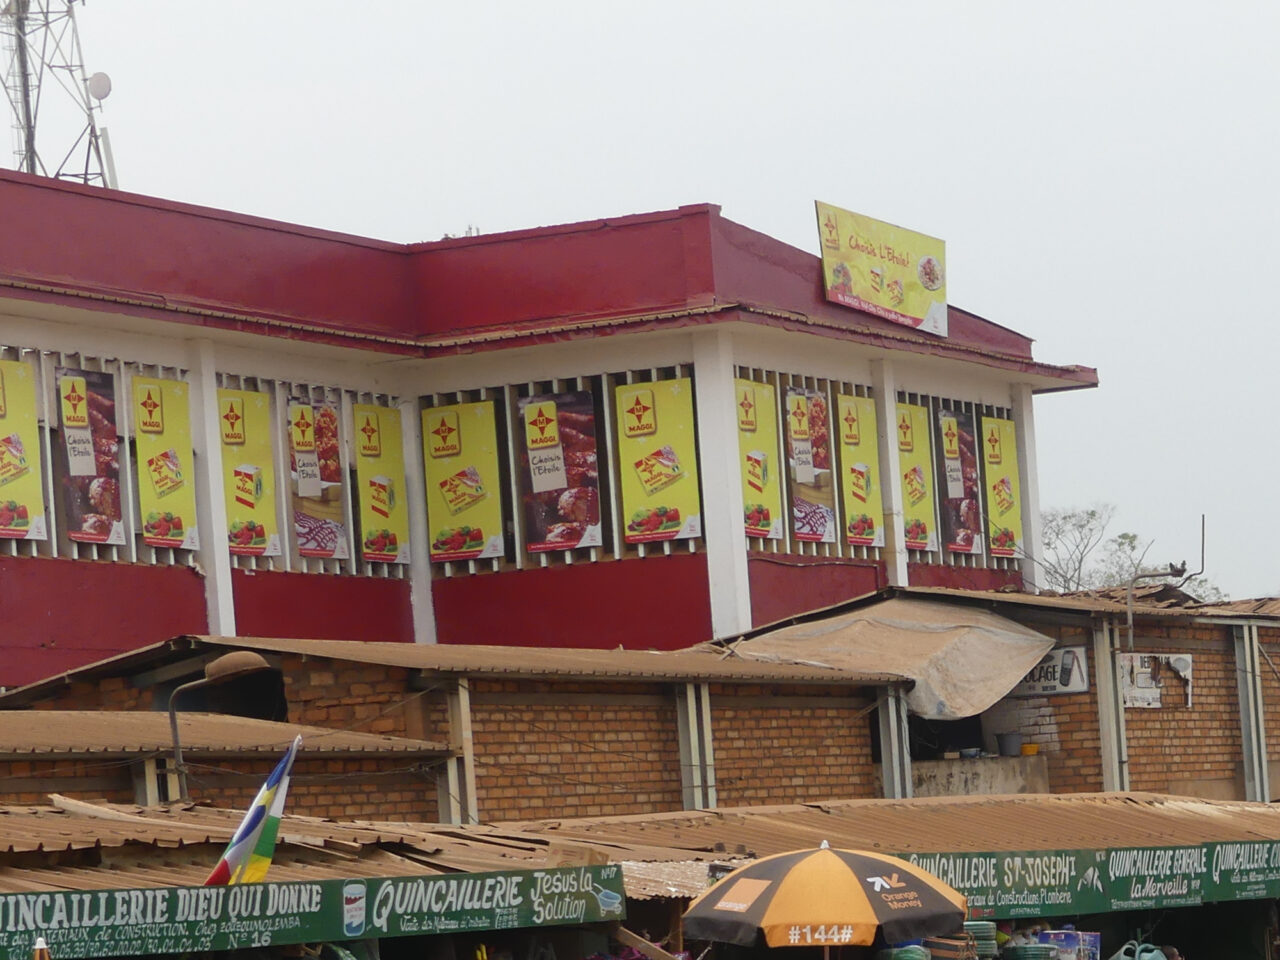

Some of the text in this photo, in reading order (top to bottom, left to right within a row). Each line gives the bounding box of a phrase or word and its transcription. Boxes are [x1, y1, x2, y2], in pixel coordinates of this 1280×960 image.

[66, 415, 87, 423] MAGGI
[142, 420, 161, 428] MAGGI
[224, 432, 242, 440] MAGGI
[628, 424, 653, 433] MAGGI
[530, 436, 556, 445] MAGGI
[433, 444, 458, 453] MAGGI
[531, 454, 561, 466] Choisis
[1109, 849, 1173, 882] QUINCAILLERIE
[579, 867, 593, 893] la
[1130, 877, 1142, 899] la
[1142, 875, 1188, 897] Merveille
[176, 887, 226, 922] DIEU
[228, 885, 264, 922] QUI
[266, 884, 322, 916] DONNE
[881, 890, 918, 904] Orange
[1040, 887, 1072, 905] Plomberie
[373, 876, 523, 932] QUINCAILLERIE
[532, 895, 586, 925] Solution
[716, 899, 747, 910] orange
[887, 899, 922, 912] Money
[95, 926, 112, 941] de
[115, 923, 189, 940] CONSTRUCTION.
[195, 920, 217, 940] Chez
[788, 924, 853, 943] #144#
[251, 931, 272, 947] 16
